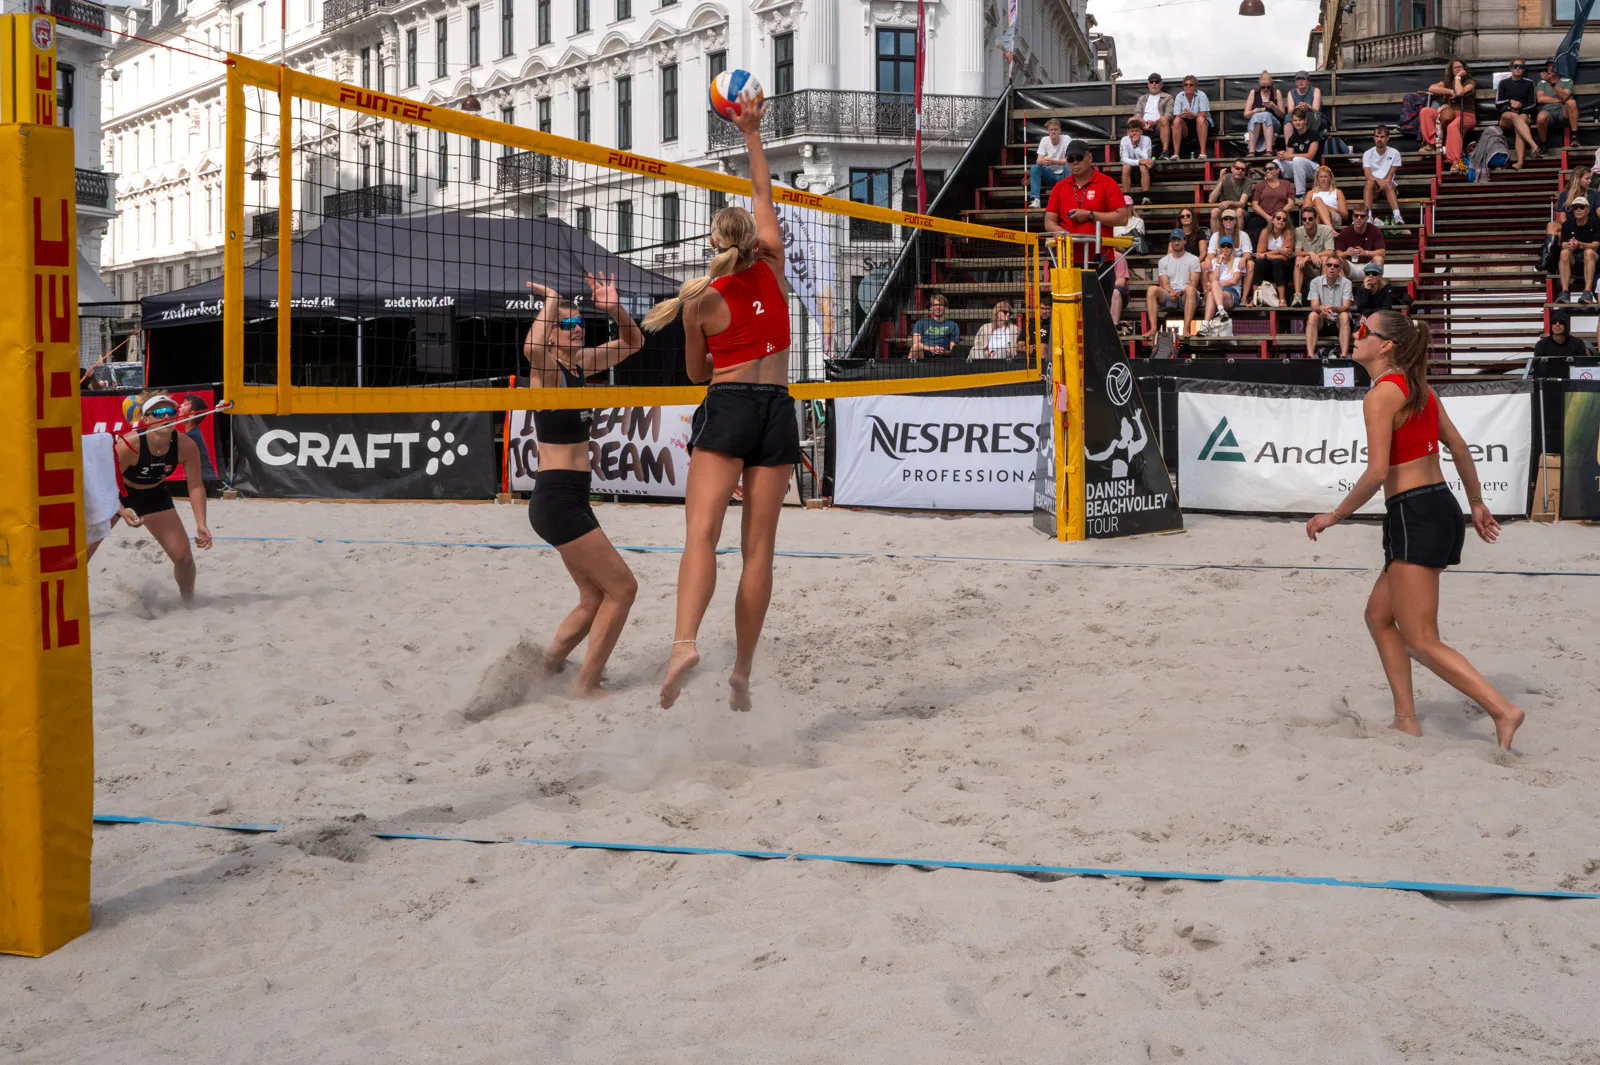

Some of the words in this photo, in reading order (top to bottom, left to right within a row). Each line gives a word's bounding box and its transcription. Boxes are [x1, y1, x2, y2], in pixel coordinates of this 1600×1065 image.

[341, 87, 433, 123] FUNTEC
[608, 152, 667, 176] FUNTEC
[782, 190, 823, 207] FUNTEC
[904, 214, 933, 228] FUNTEC
[994, 229, 1016, 241] FUNTEC
[385, 296, 455, 308] zederkof.dk
[752, 300, 765, 315] 2
[34, 196, 81, 650] FUNTEC
[256, 429, 420, 469] CRAFT
[140, 467, 150, 475] 2
[1086, 479, 1135, 500] DANISH
[1086, 493, 1168, 517] BEACHVOLLEY
[1087, 516, 1119, 535] TOUR
